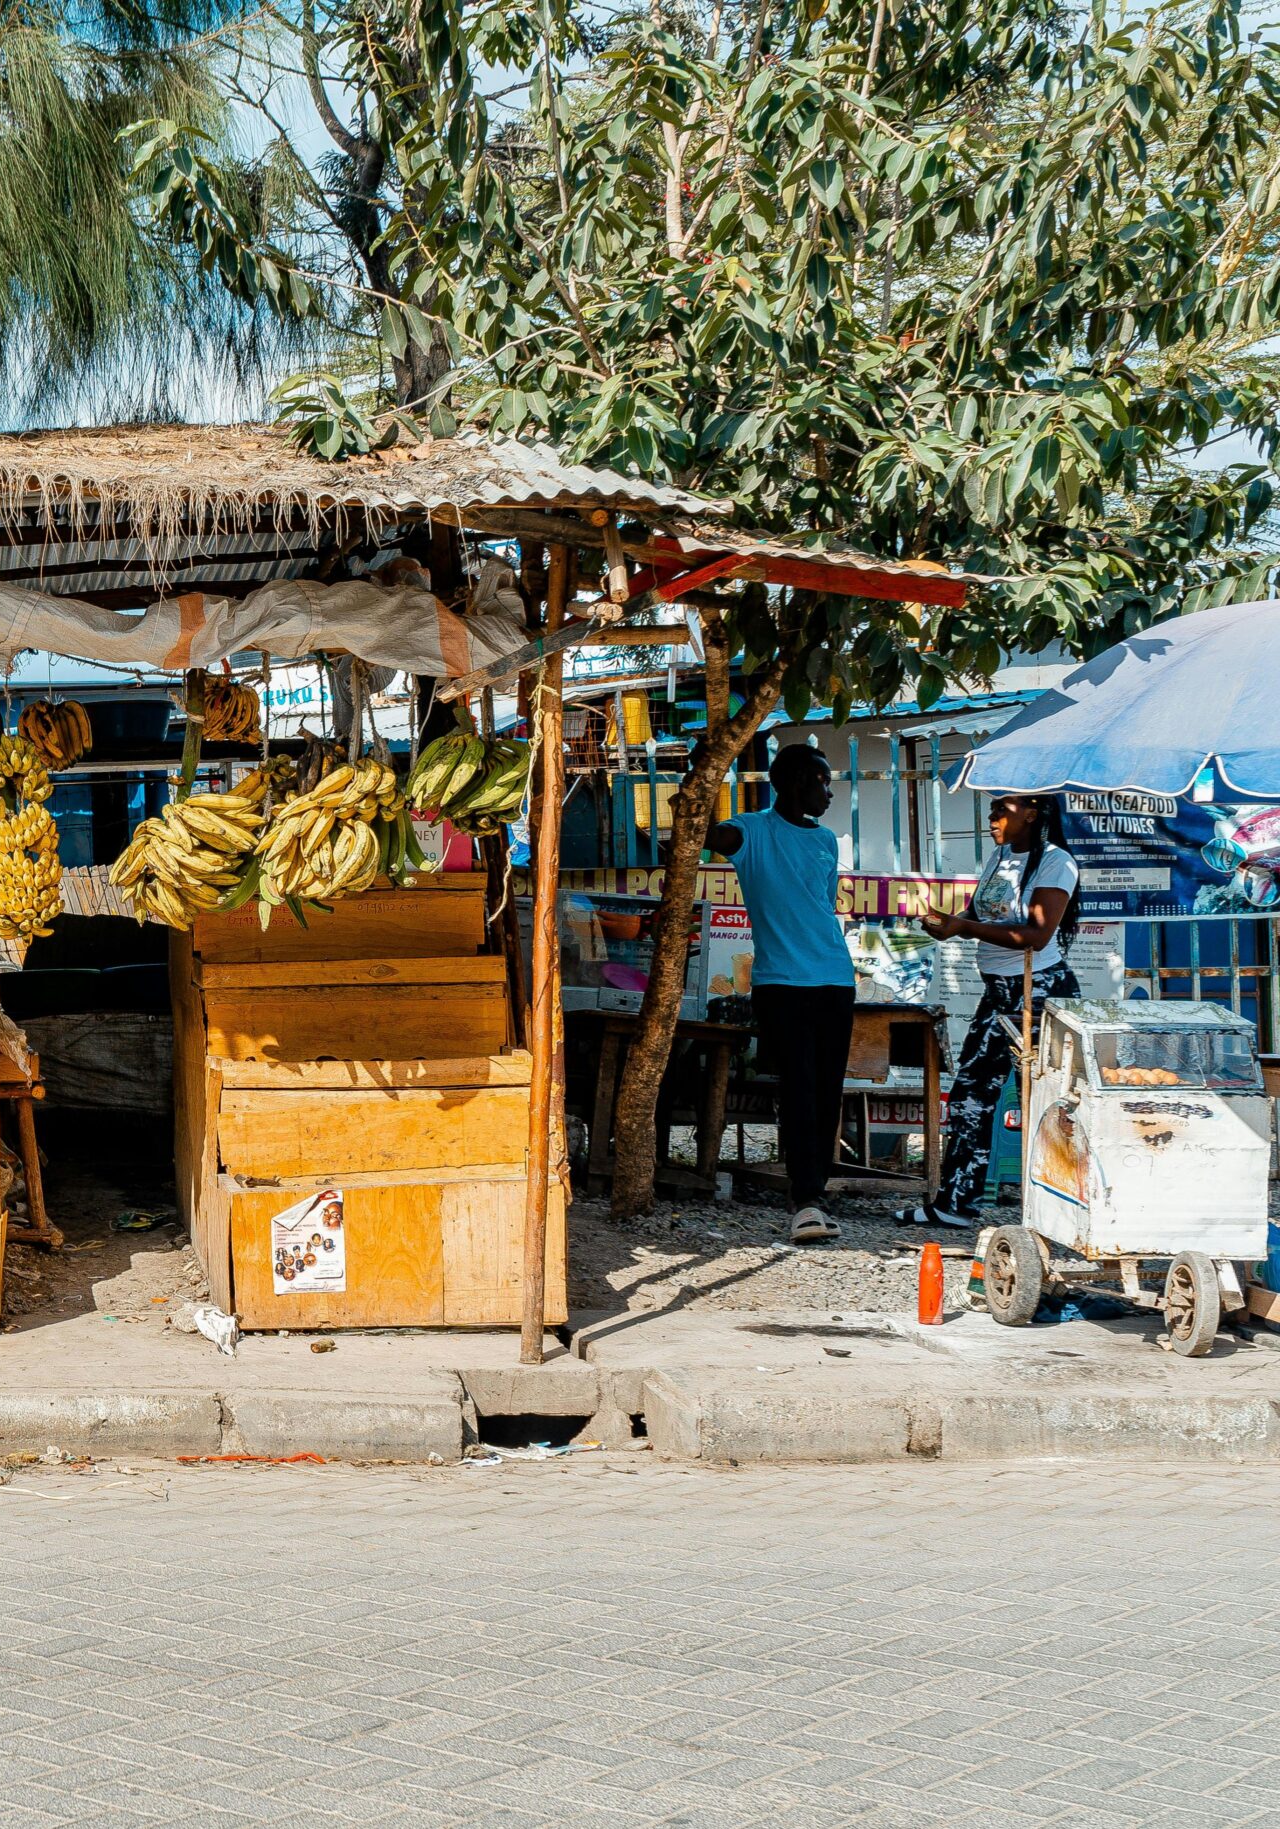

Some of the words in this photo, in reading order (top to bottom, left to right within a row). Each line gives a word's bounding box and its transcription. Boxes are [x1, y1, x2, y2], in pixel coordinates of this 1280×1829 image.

[1069, 792, 1108, 811] PHEM
[1113, 794, 1175, 815] SEAFOOD
[1089, 814, 1156, 835] VENTURES
[415, 830, 438, 841] NEY
[710, 910, 748, 927] Tasty
[710, 931, 738, 940] MANGO
[1082, 925, 1105, 935] JUICE
